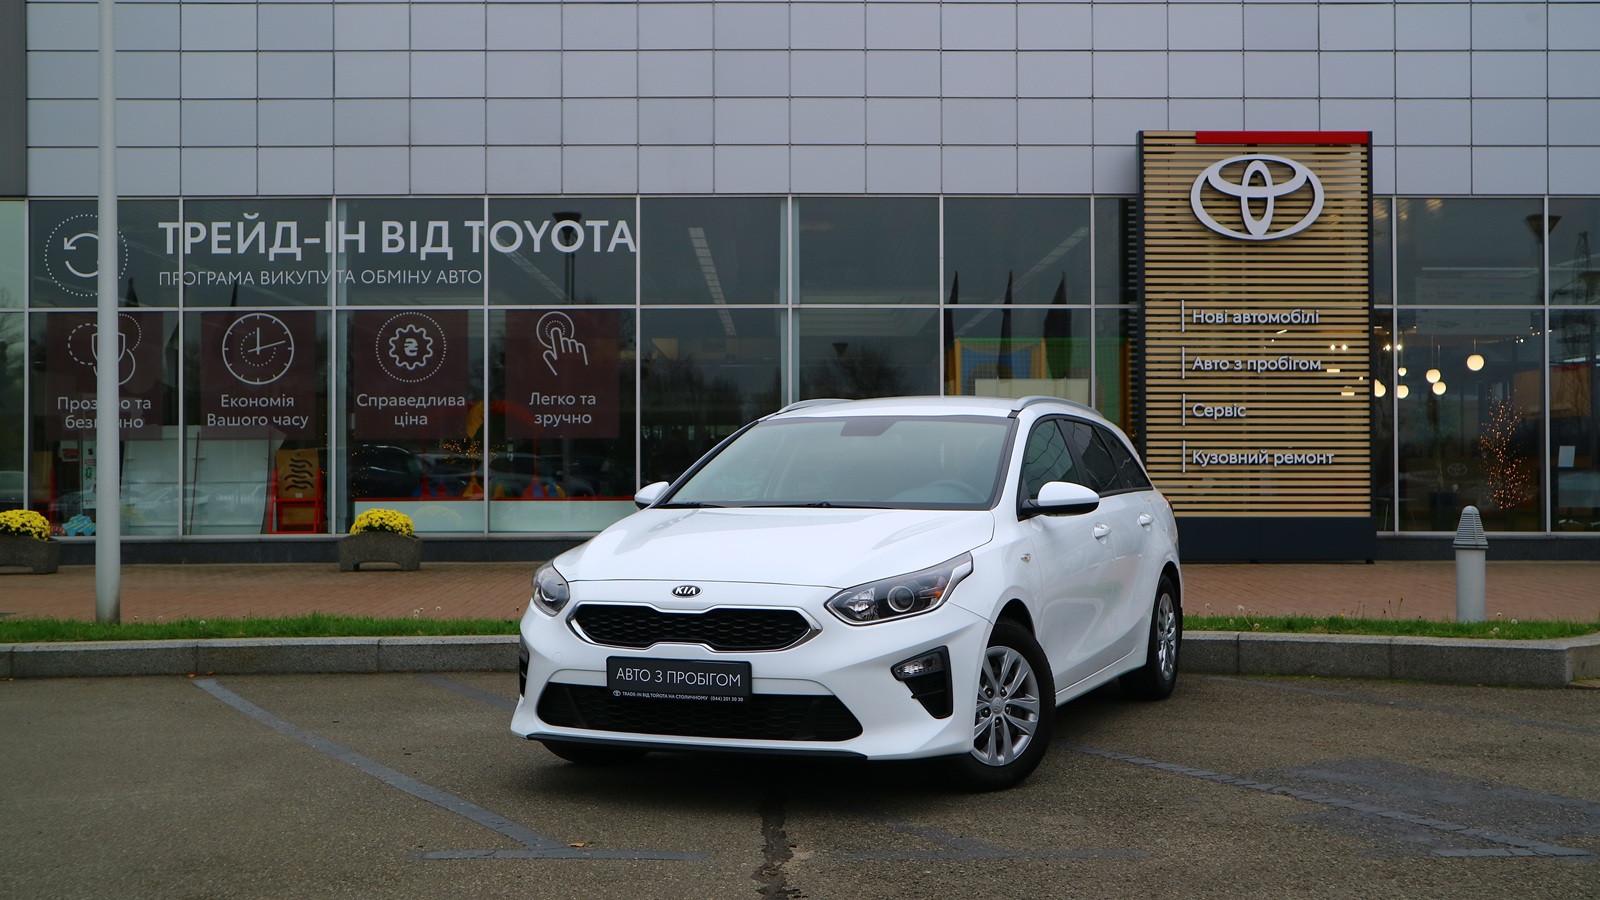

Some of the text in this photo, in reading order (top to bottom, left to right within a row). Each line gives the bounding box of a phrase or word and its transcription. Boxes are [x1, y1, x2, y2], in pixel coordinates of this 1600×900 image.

[158, 213, 636, 261] ТРЕЙД-ІН ВІД TOYOTA
[159, 269, 482, 286] ПРОГРАМА ВИКУПУ ТА ОБМІНУ АВТО
[1192, 309, 1319, 324] Нові автомобілі
[1192, 356, 1321, 374] Авто з пробігом
[57, 396, 151, 413] Прозо та
[220, 394, 294, 408] Економія
[356, 394, 466, 410] Справедлива
[529, 392, 596, 406] Легко та
[534, 412, 592, 428] зручно
[1192, 403, 1247, 420] Сервіс
[207, 413, 309, 430] Вашого часу
[394, 413, 428, 428] ціна
[1192, 449, 1334, 468] Кузовний ремонт
[675, 586, 696, 595] KIA
[616, 667, 651, 682] АВТО
[667, 670, 741, 687] ПРОБІГОМ
